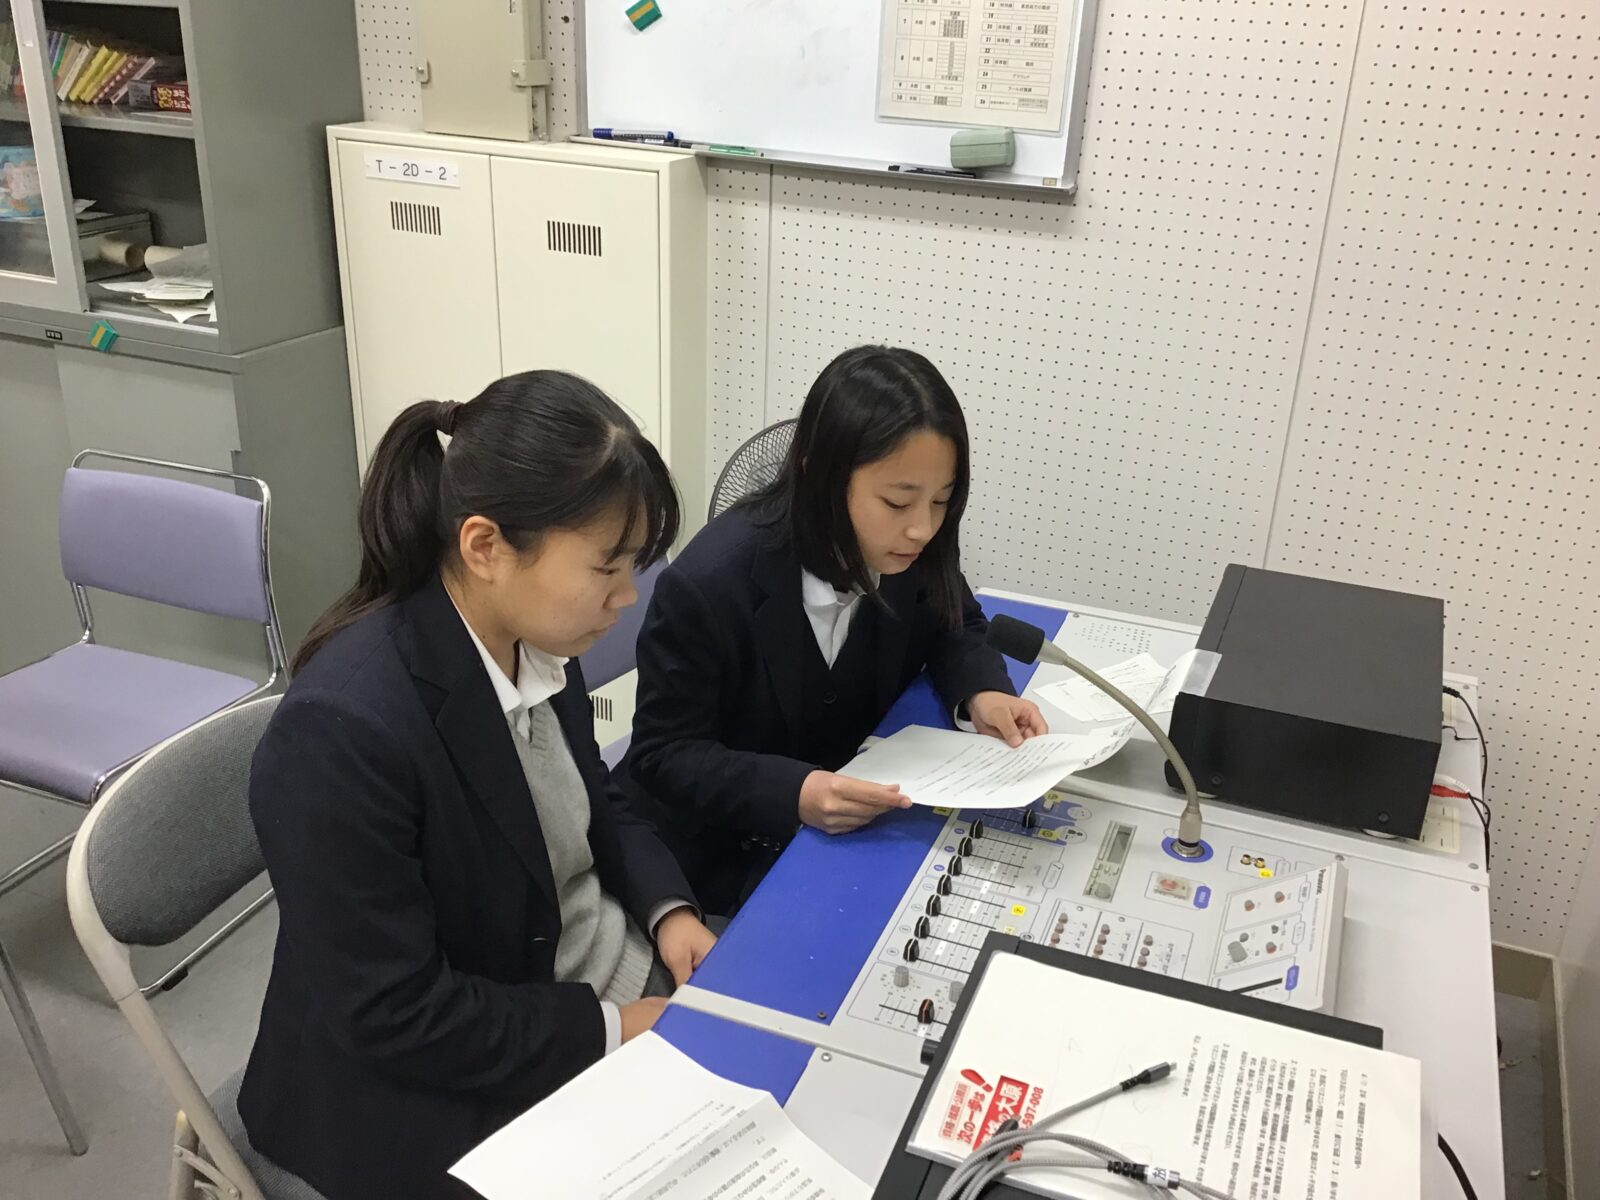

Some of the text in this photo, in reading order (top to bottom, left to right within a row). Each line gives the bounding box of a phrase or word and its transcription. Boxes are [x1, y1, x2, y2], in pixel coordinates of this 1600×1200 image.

[957, 1091, 985, 1144] 次の一歩は
